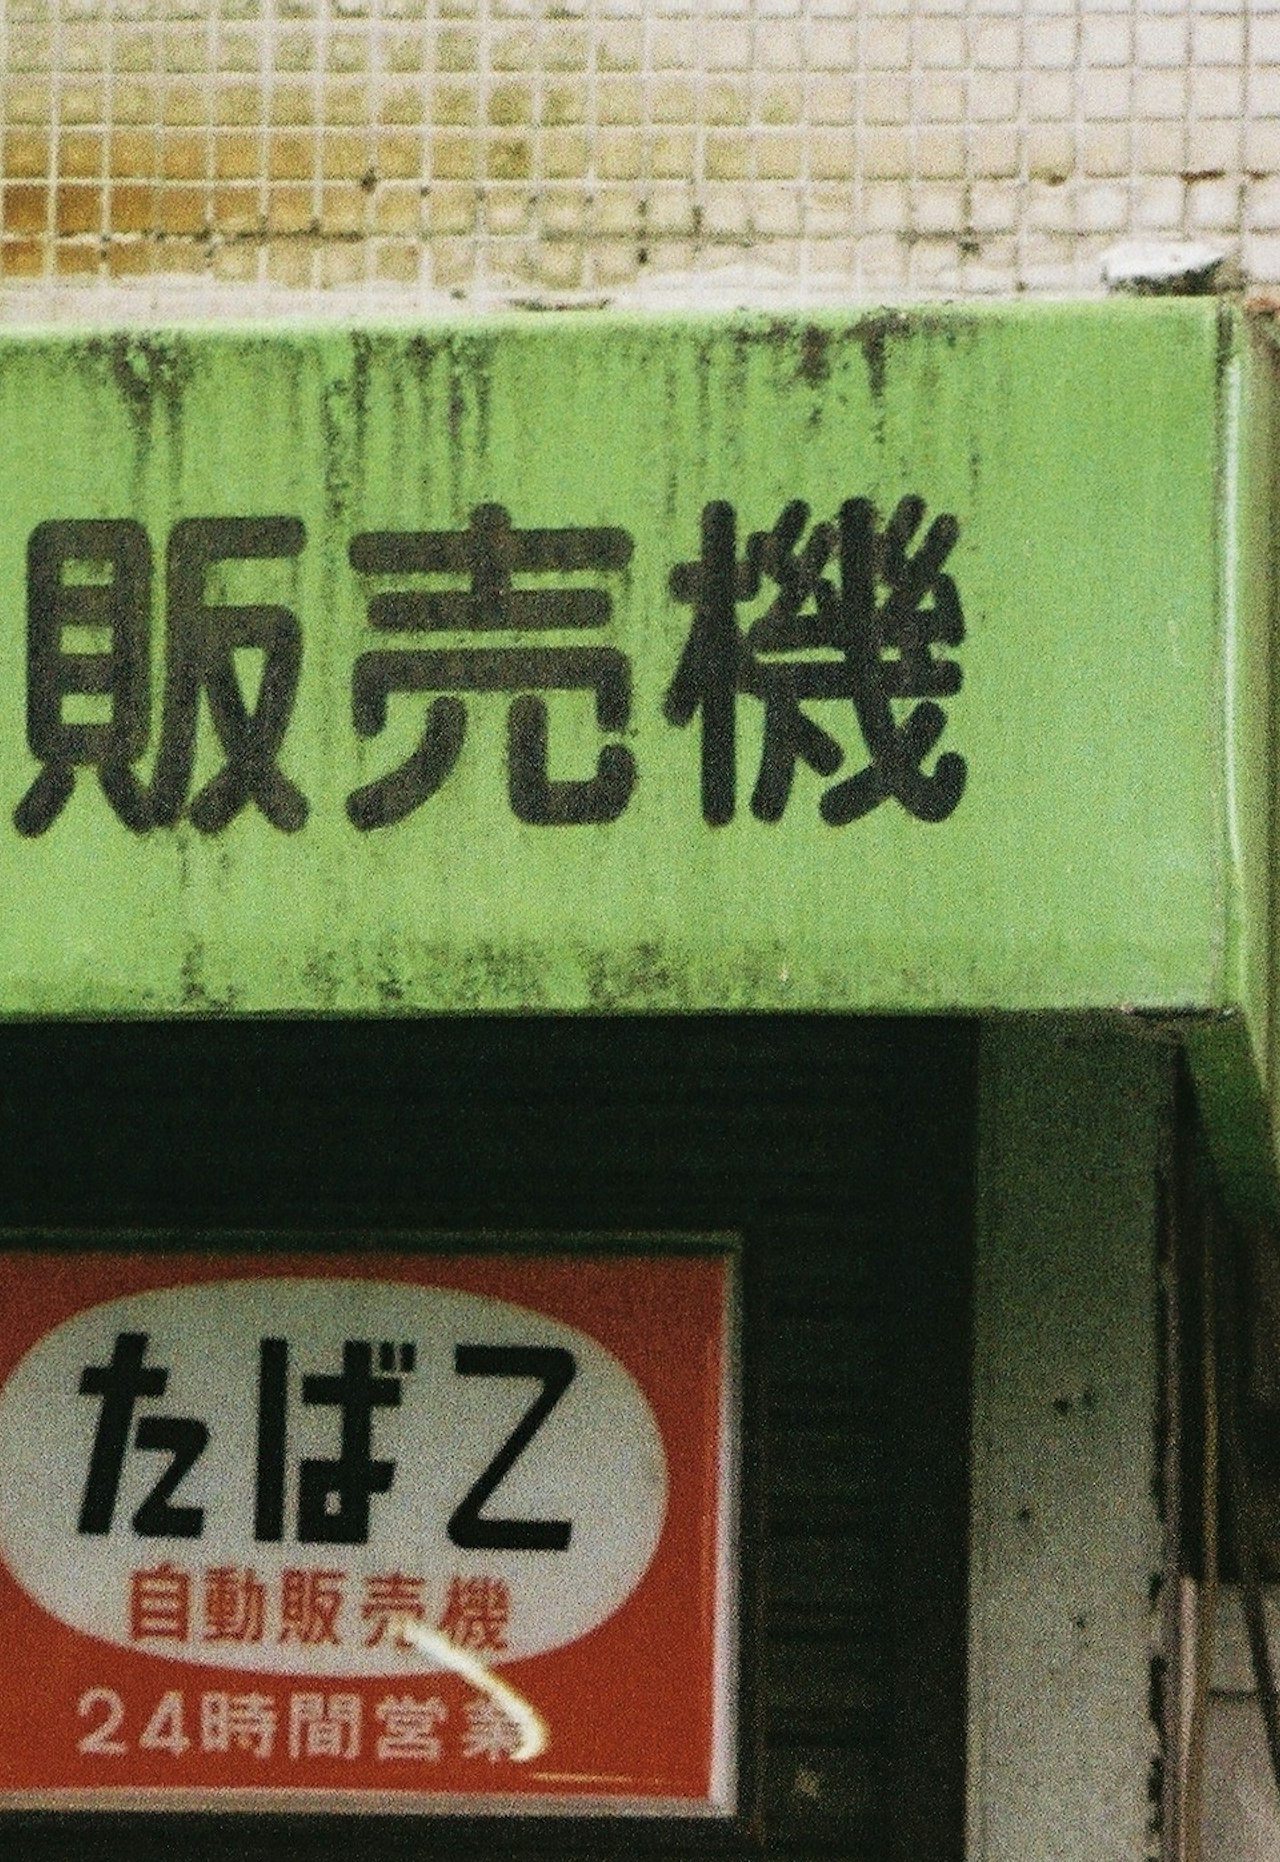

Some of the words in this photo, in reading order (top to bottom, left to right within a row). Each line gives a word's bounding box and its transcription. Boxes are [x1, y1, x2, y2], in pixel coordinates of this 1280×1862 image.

[78, 1331, 578, 1551] たばこ
[127, 1563, 510, 1652] 自動販売機
